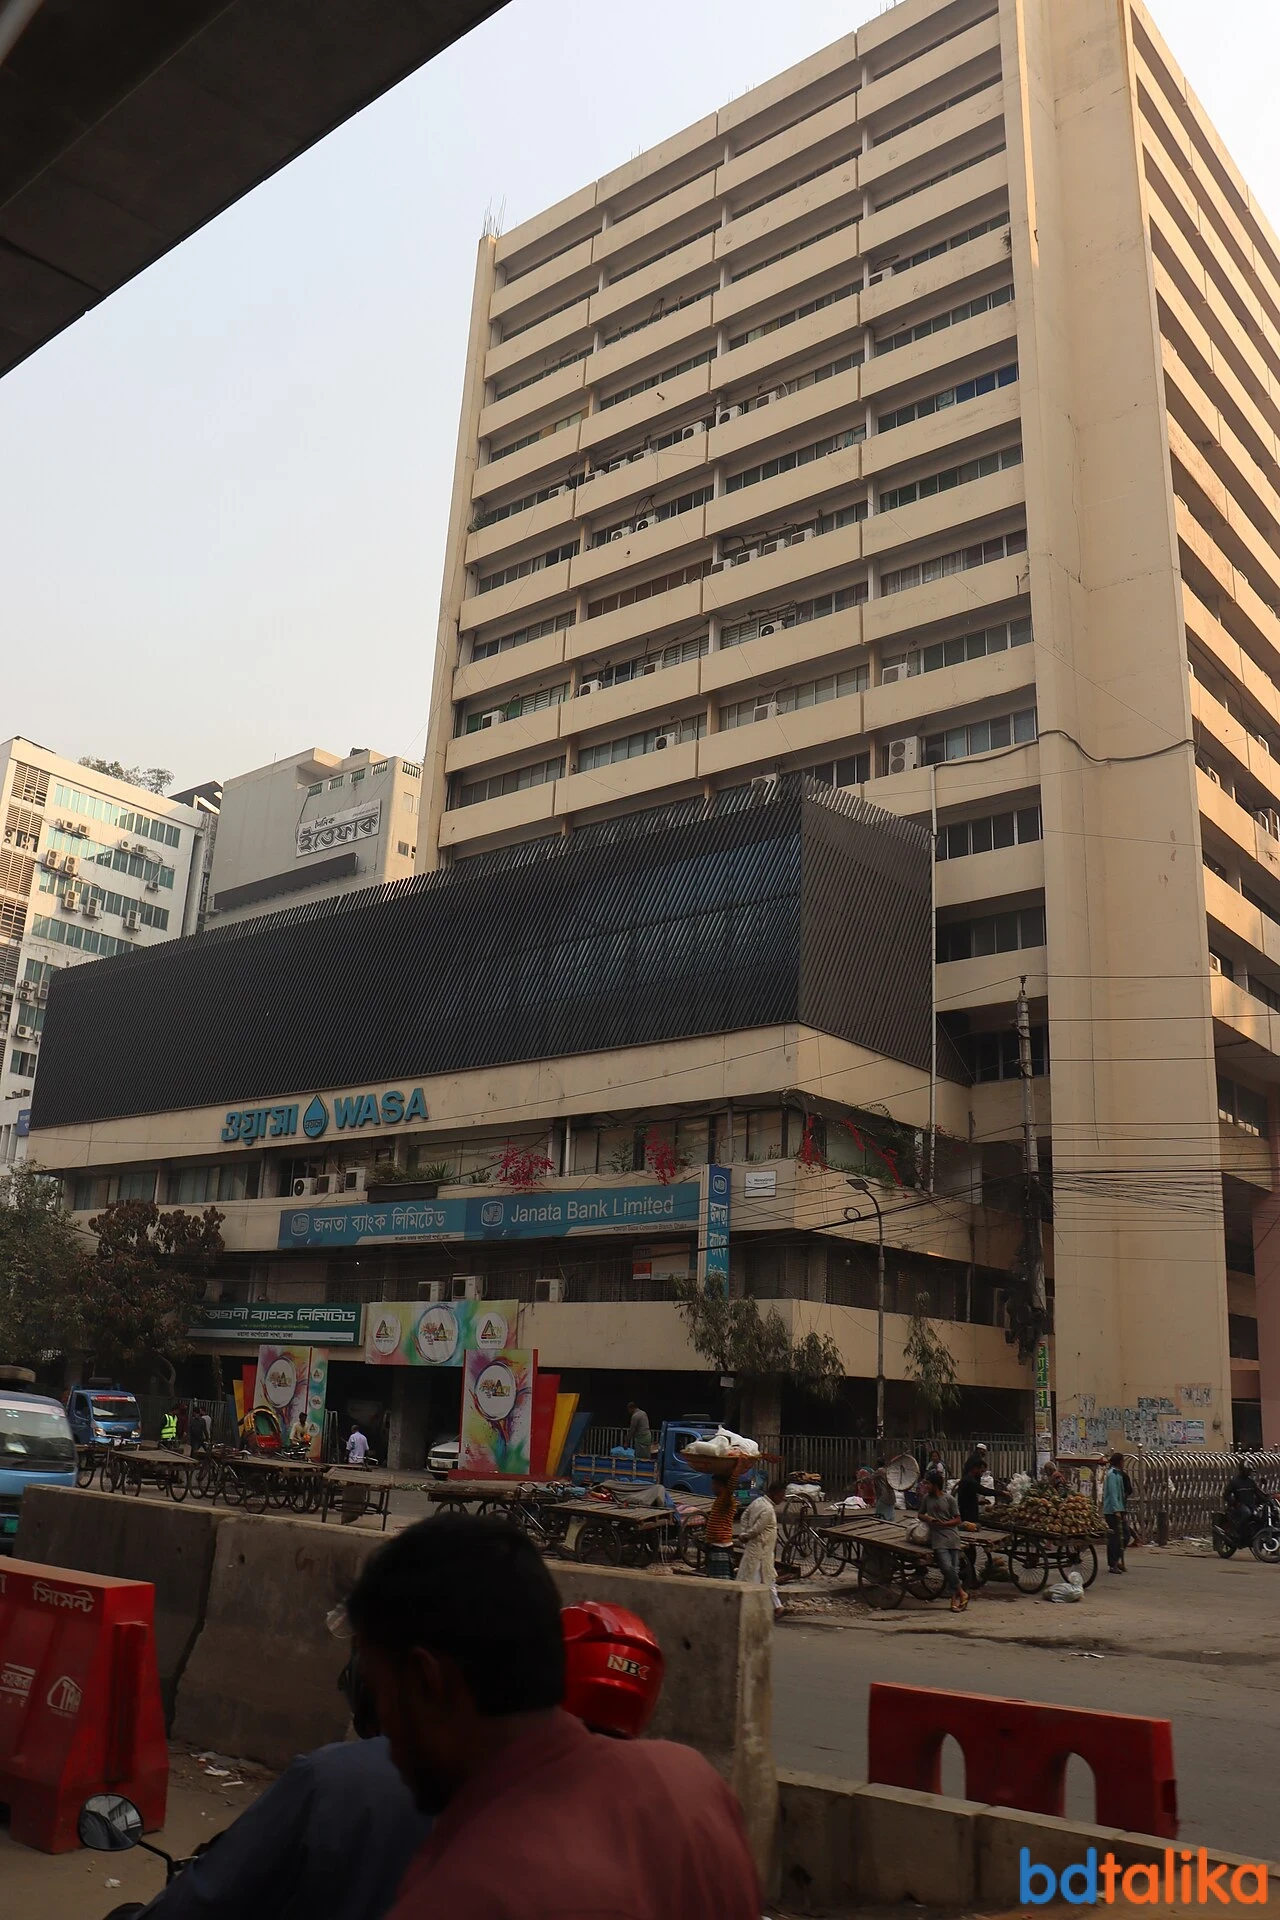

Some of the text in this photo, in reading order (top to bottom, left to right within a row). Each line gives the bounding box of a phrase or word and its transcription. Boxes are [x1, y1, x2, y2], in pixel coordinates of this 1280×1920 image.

[334, 1087, 429, 1129] WASA
[221, 1104, 299, 1145] ওয়াসা
[313, 1206, 447, 1233] জনতা ব্যাংক লিমিটেড
[511, 1195, 674, 1223] Janata Bank Limited
[251, 1310, 294, 1322] ব্যাংক
[32, 1581, 95, 1612] সিমেন্ট
